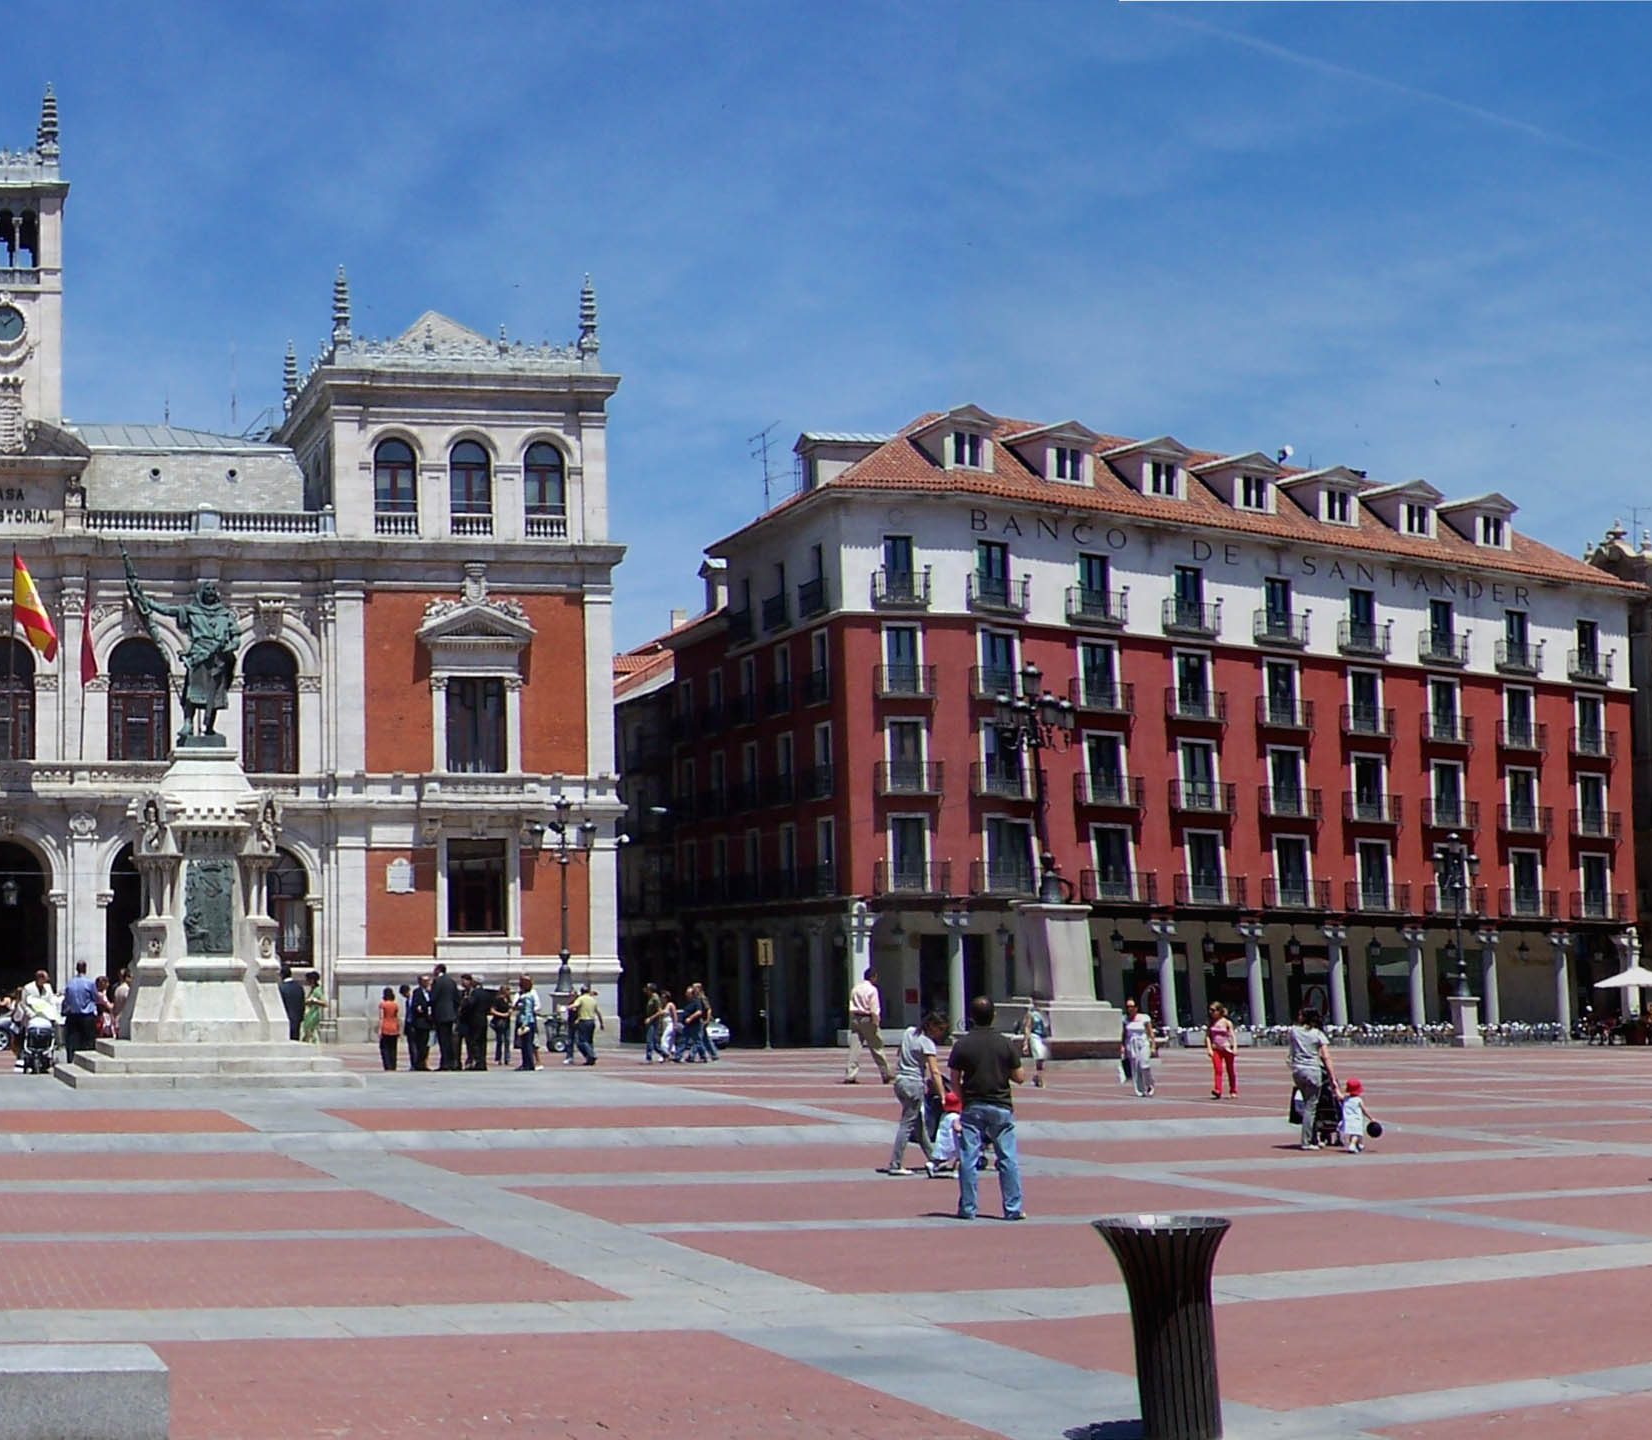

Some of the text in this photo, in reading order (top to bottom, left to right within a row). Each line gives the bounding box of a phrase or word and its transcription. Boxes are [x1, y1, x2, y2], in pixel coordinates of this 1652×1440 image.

[970, 507, 1532, 607] BANCO DE SANTANDER
